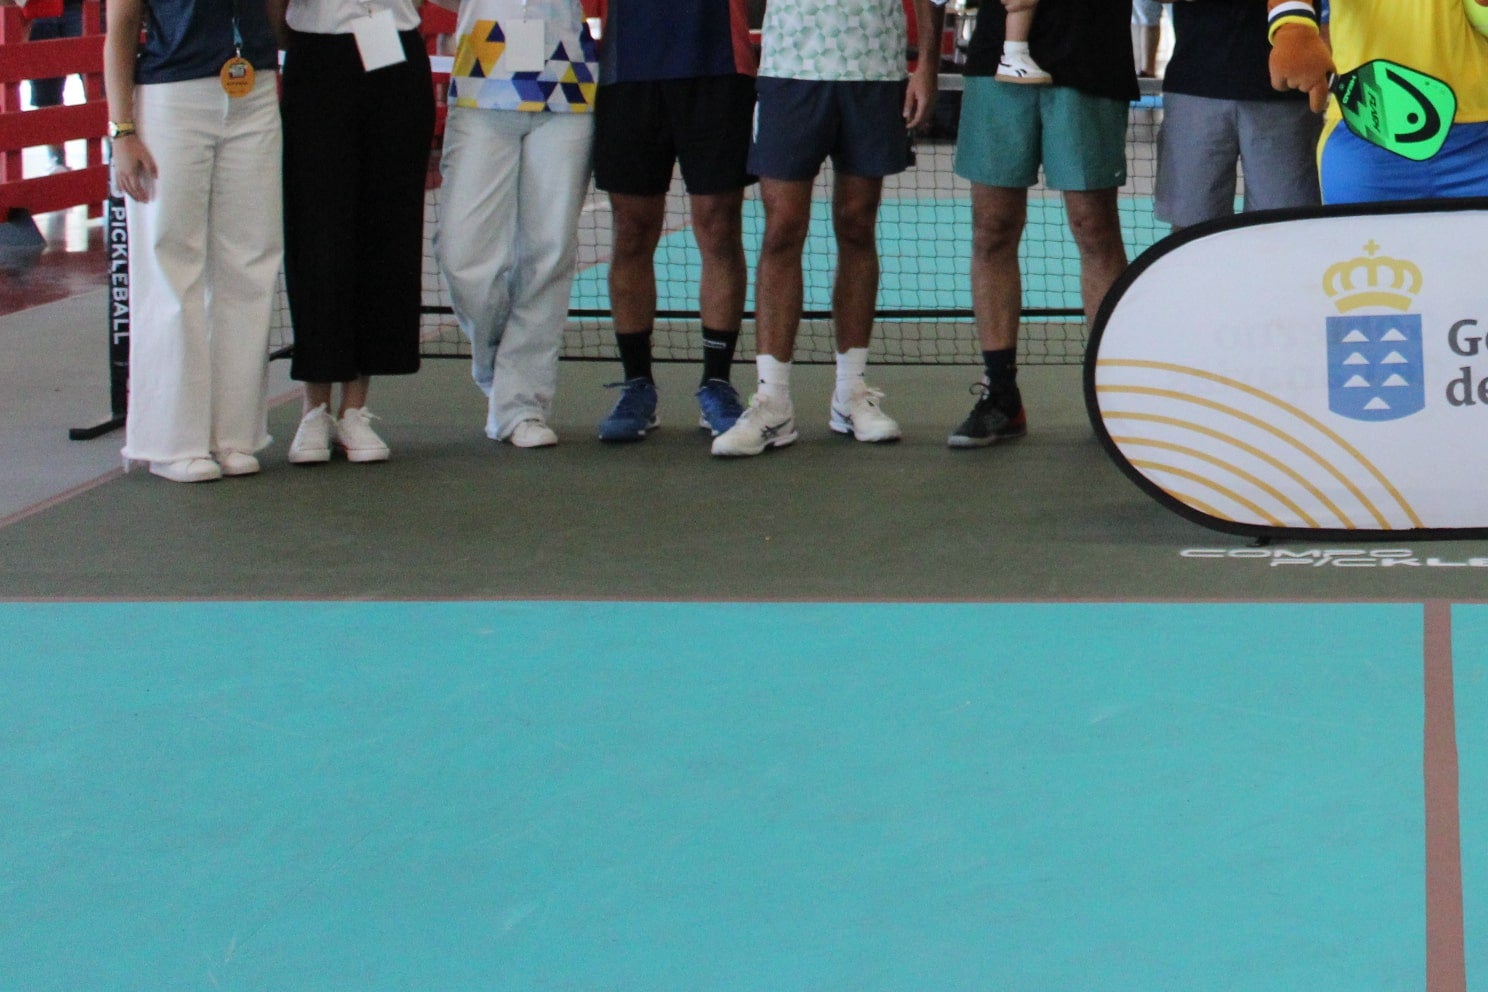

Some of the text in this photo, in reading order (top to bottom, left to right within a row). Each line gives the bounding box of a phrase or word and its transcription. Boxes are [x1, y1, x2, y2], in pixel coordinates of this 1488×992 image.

[1342, 74, 1357, 104] HEAD
[110, 206, 130, 346] PICKLEBALL
[1180, 549, 1412, 558] COMPO
